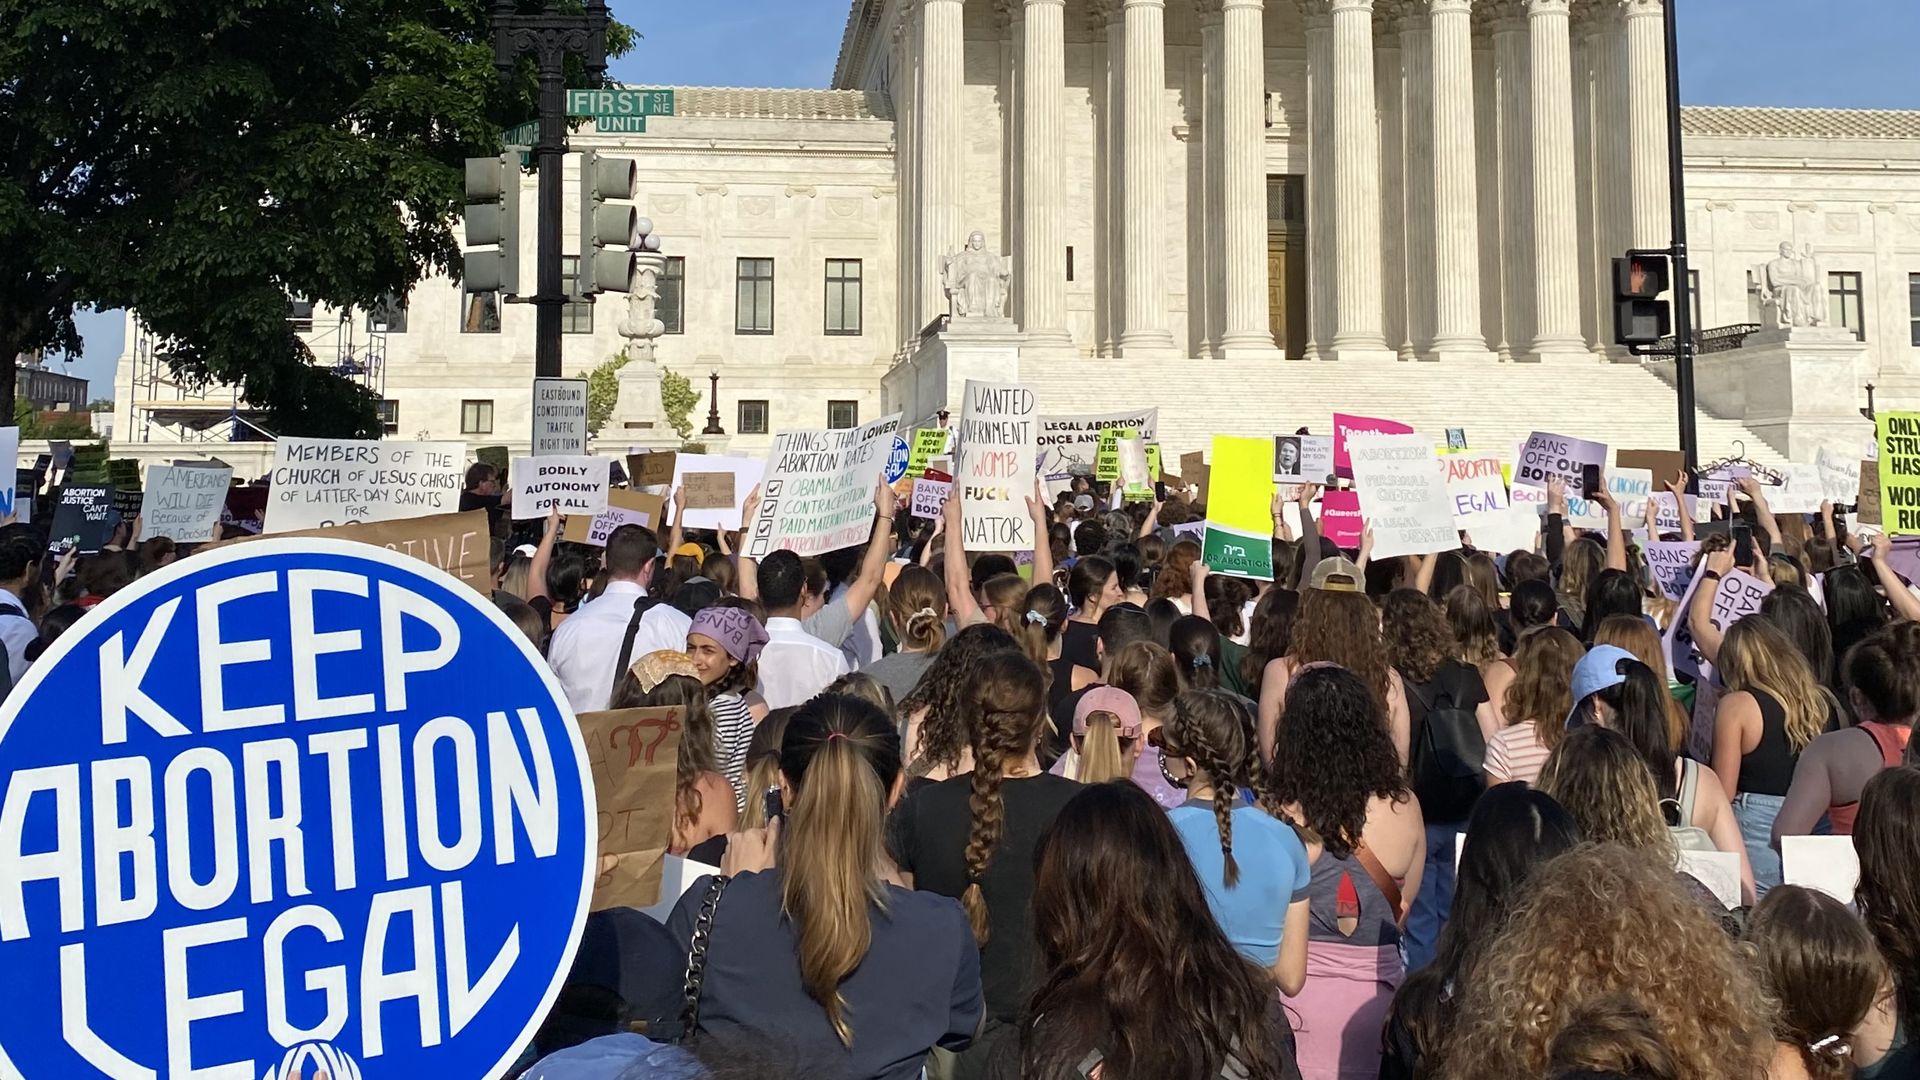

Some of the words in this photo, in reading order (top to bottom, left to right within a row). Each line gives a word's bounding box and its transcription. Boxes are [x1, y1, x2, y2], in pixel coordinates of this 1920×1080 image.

[574, 92, 649, 113] FIRST
[653, 93, 668, 102] ST
[653, 103, 670, 113] NE
[599, 117, 643, 131] UNIT
[541, 389, 581, 400] EASTBOUND
[974, 386, 1034, 415] WANTED
[536, 405, 585, 417] CONSTITUTION
[546, 422, 574, 433] TRAFFIC
[961, 418, 1030, 444] OVERNMENT
[1044, 422, 1082, 431] LEGAL
[1086, 418, 1145, 430] ABORTION
[540, 438, 560, 450] RIGHT
[562, 438, 580, 449] TURN
[776, 431, 830, 452] THINGS
[834, 427, 862, 450] THAT
[862, 420, 899, 442] LOWER
[1037, 434, 1073, 446] ONCE
[1077, 434, 1101, 443] AND
[1358, 446, 1428, 461] ABORTION
[1529, 437, 1568, 456] BANS
[1885, 436, 1920, 455] STRU
[287, 444, 380, 464] MEMBERS
[391, 450, 414, 465] OF
[424, 452, 453, 468] THE
[776, 452, 840, 473] ABORTION
[843, 439, 877, 470] RATES
[1525, 451, 1555, 467] OFF
[1556, 458, 1583, 474] OU
[539, 466, 588, 476] BODILY
[971, 451, 1018, 478] WOMB
[162, 467, 227, 489] AMERICANS
[275, 467, 340, 486] CHURCH
[348, 471, 365, 482] OF
[369, 470, 417, 486] JESUS
[420, 472, 463, 490] CHRIST
[789, 472, 854, 497] OBAMACARE
[62, 488, 106, 497] ABORTION
[525, 482, 600, 495] AUTONOMY
[916, 483, 946, 496] BANS
[965, 486, 1010, 500] FUCK
[60, 496, 94, 505] JUSTICE
[157, 490, 190, 508] WILL
[195, 493, 216, 508] DIE
[280, 490, 299, 502] OF
[306, 488, 389, 503] LATTER-DAY
[394, 489, 442, 508] SAINTS
[536, 499, 561, 509] FOR
[564, 499, 589, 508] ALL
[783, 485, 868, 514] CONTRACEPTION
[916, 493, 937, 504] OFF
[1453, 491, 1506, 516] EGAL
[83, 504, 108, 513] CAN'T
[86, 512, 108, 521] WAIT.
[345, 505, 370, 516] FOR
[1662, 508, 1679, 518] OU
[151, 509, 192, 525] Because
[196, 510, 209, 521] of
[594, 519, 615, 531] OFF
[779, 516, 806, 534] PAID
[806, 508, 851, 533] MATERNITY
[851, 503, 873, 521] LEAVE
[1655, 518, 1681, 529] DIES
[964, 517, 1025, 544] NATOR
[1206, 553, 1220, 564] OR
[1219, 556, 1270, 569] ABORTION
[1648, 548, 1689, 563] BANS
[1655, 564, 1680, 581] OFF
[1715, 577, 1742, 619] OFF
[696, 612, 744, 645] BANS
[100, 569, 461, 744] KEEP
[0, 707, 559, 941] ABORTION
[59, 881, 520, 1080] LEGAL
